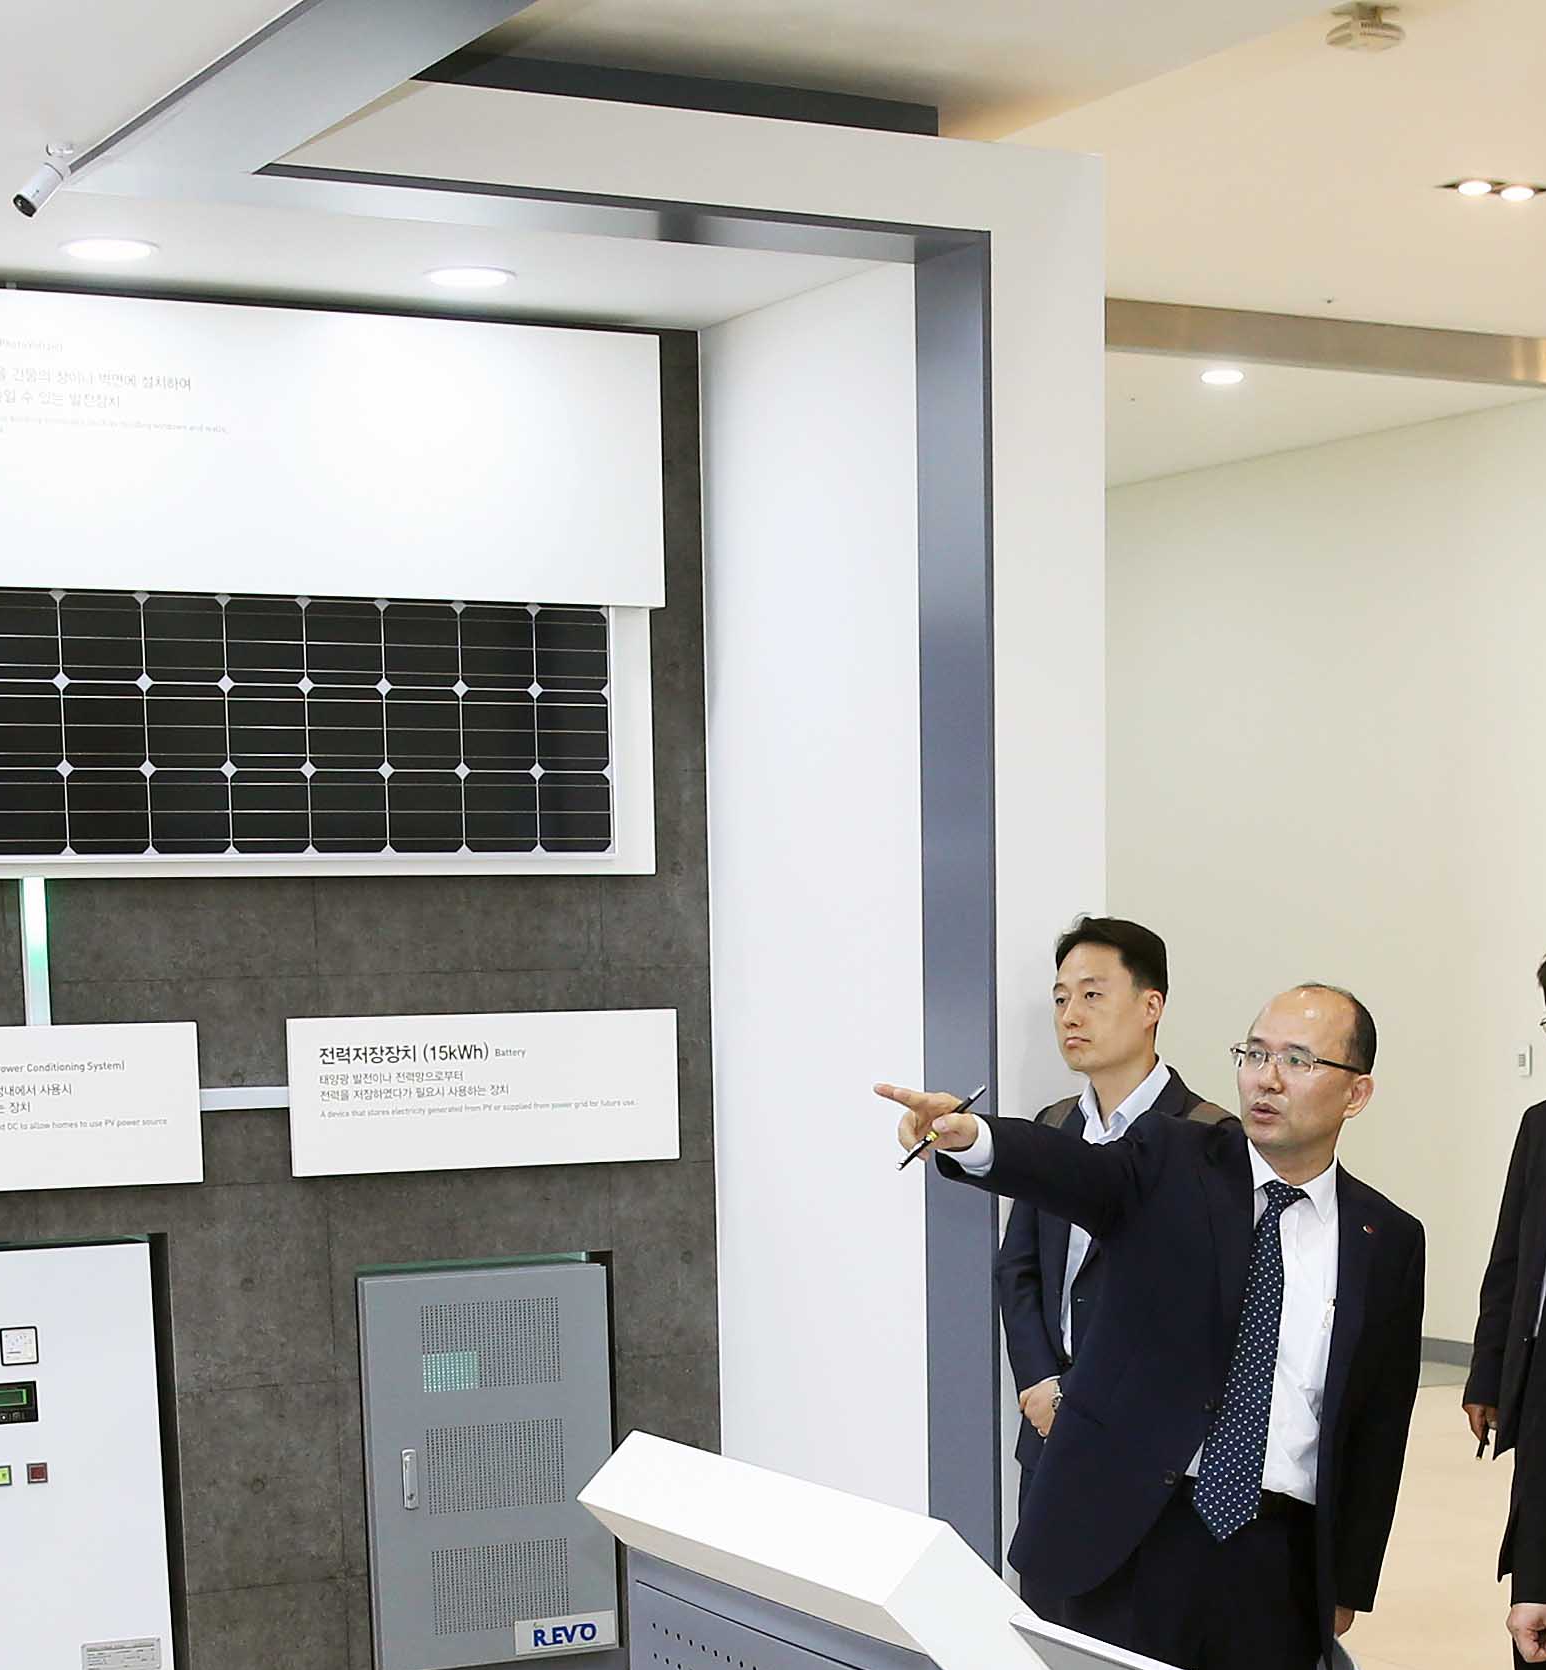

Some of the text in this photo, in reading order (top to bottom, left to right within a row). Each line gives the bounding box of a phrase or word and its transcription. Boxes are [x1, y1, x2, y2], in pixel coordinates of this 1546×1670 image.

[319, 1042, 527, 1065] 전력저장장치 (15kWh) Battery
[27, 1062, 85, 1074] Conditioning
[319, 1073, 349, 1086] 태양광
[353, 1072, 392, 1085] 발전이나
[40, 1083, 72, 1096] 사용시
[320, 1089, 349, 1102] 전력을
[489, 1083, 509, 1096] 장치
[9, 1101, 31, 1114] 장치
[533, 1623, 597, 1647] REVO
